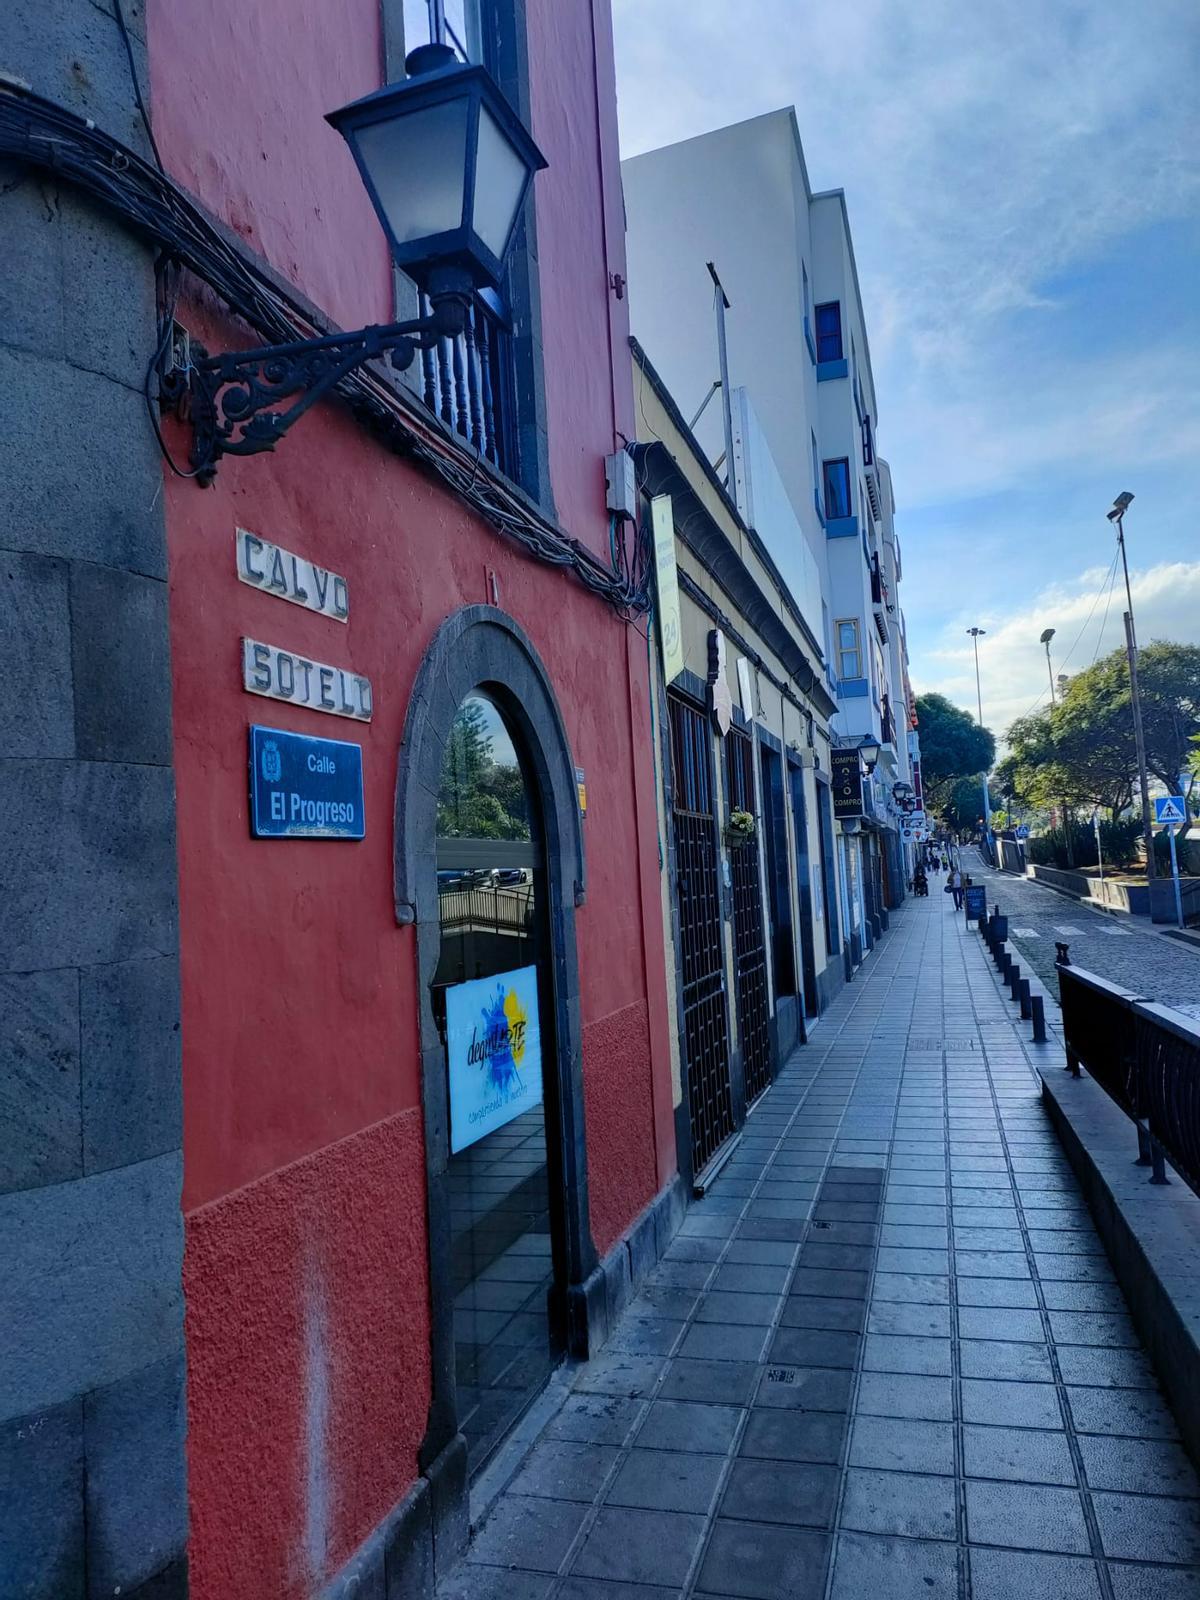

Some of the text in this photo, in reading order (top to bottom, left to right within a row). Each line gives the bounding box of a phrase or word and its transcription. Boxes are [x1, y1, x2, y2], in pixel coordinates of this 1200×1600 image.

[245, 534, 349, 619] CALVO
[253, 644, 372, 718] SOTELO
[307, 753, 336, 775] Calle
[832, 755, 859, 765] COMPRO
[841, 767, 851, 796] OO
[271, 791, 355, 827] El Progreso
[834, 798, 862, 807] COMPRO
